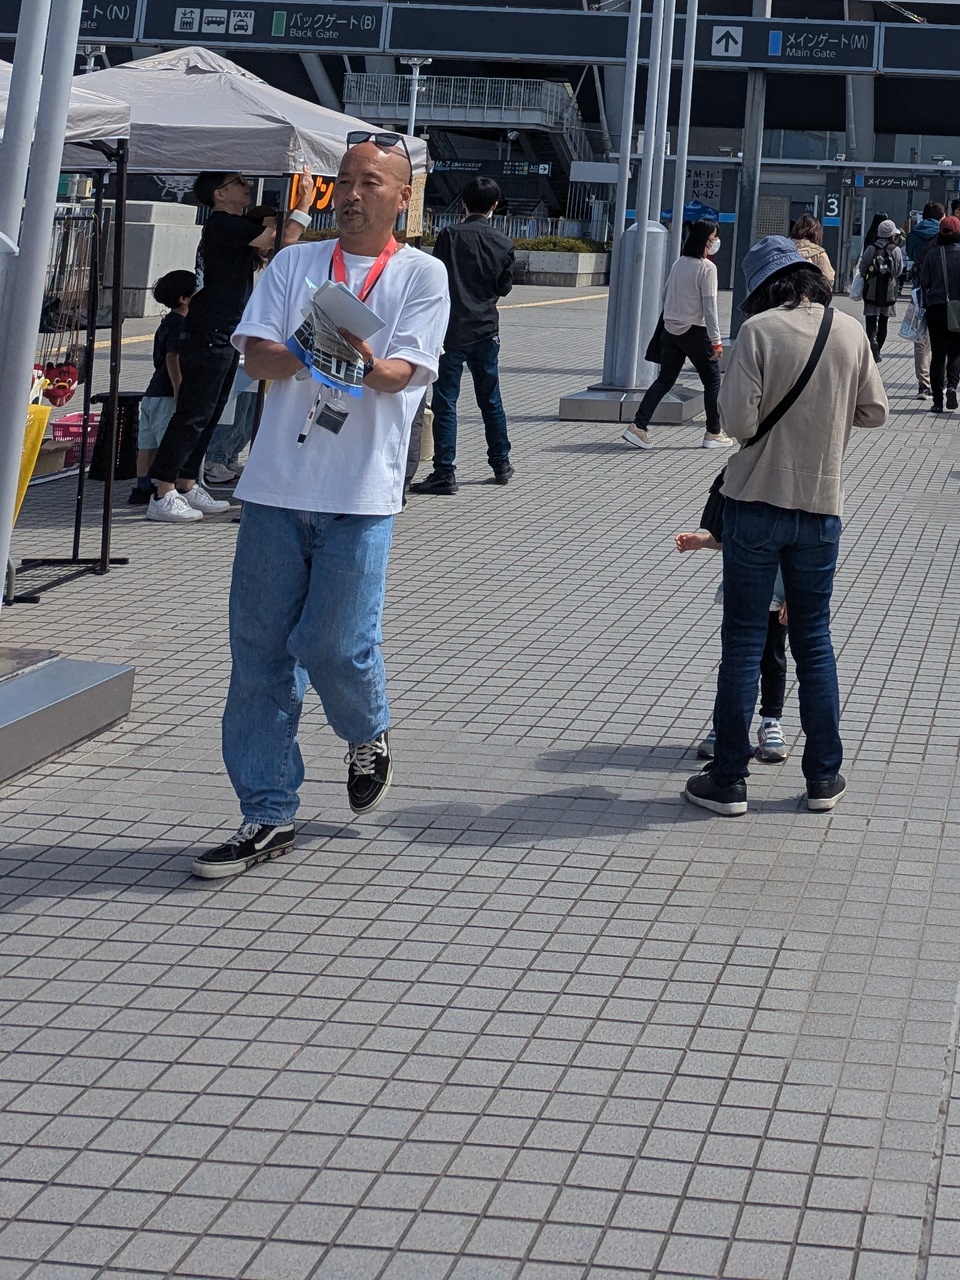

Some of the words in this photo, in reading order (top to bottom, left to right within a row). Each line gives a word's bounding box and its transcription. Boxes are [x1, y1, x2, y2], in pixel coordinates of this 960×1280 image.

[232, 11, 253, 19] TAXI
[80, 21, 98, 29] ate
[290, 12, 376, 31] バックゲート(B)
[289, 28, 313, 38] Back
[316, 29, 339, 39] Gate
[786, 32, 869, 50] メインゲート(M)
[786, 47, 810, 57] Main
[813, 48, 837, 58] Gate
[867, 178, 918, 187] メインゲート(M)
[826, 198, 839, 216] 3
